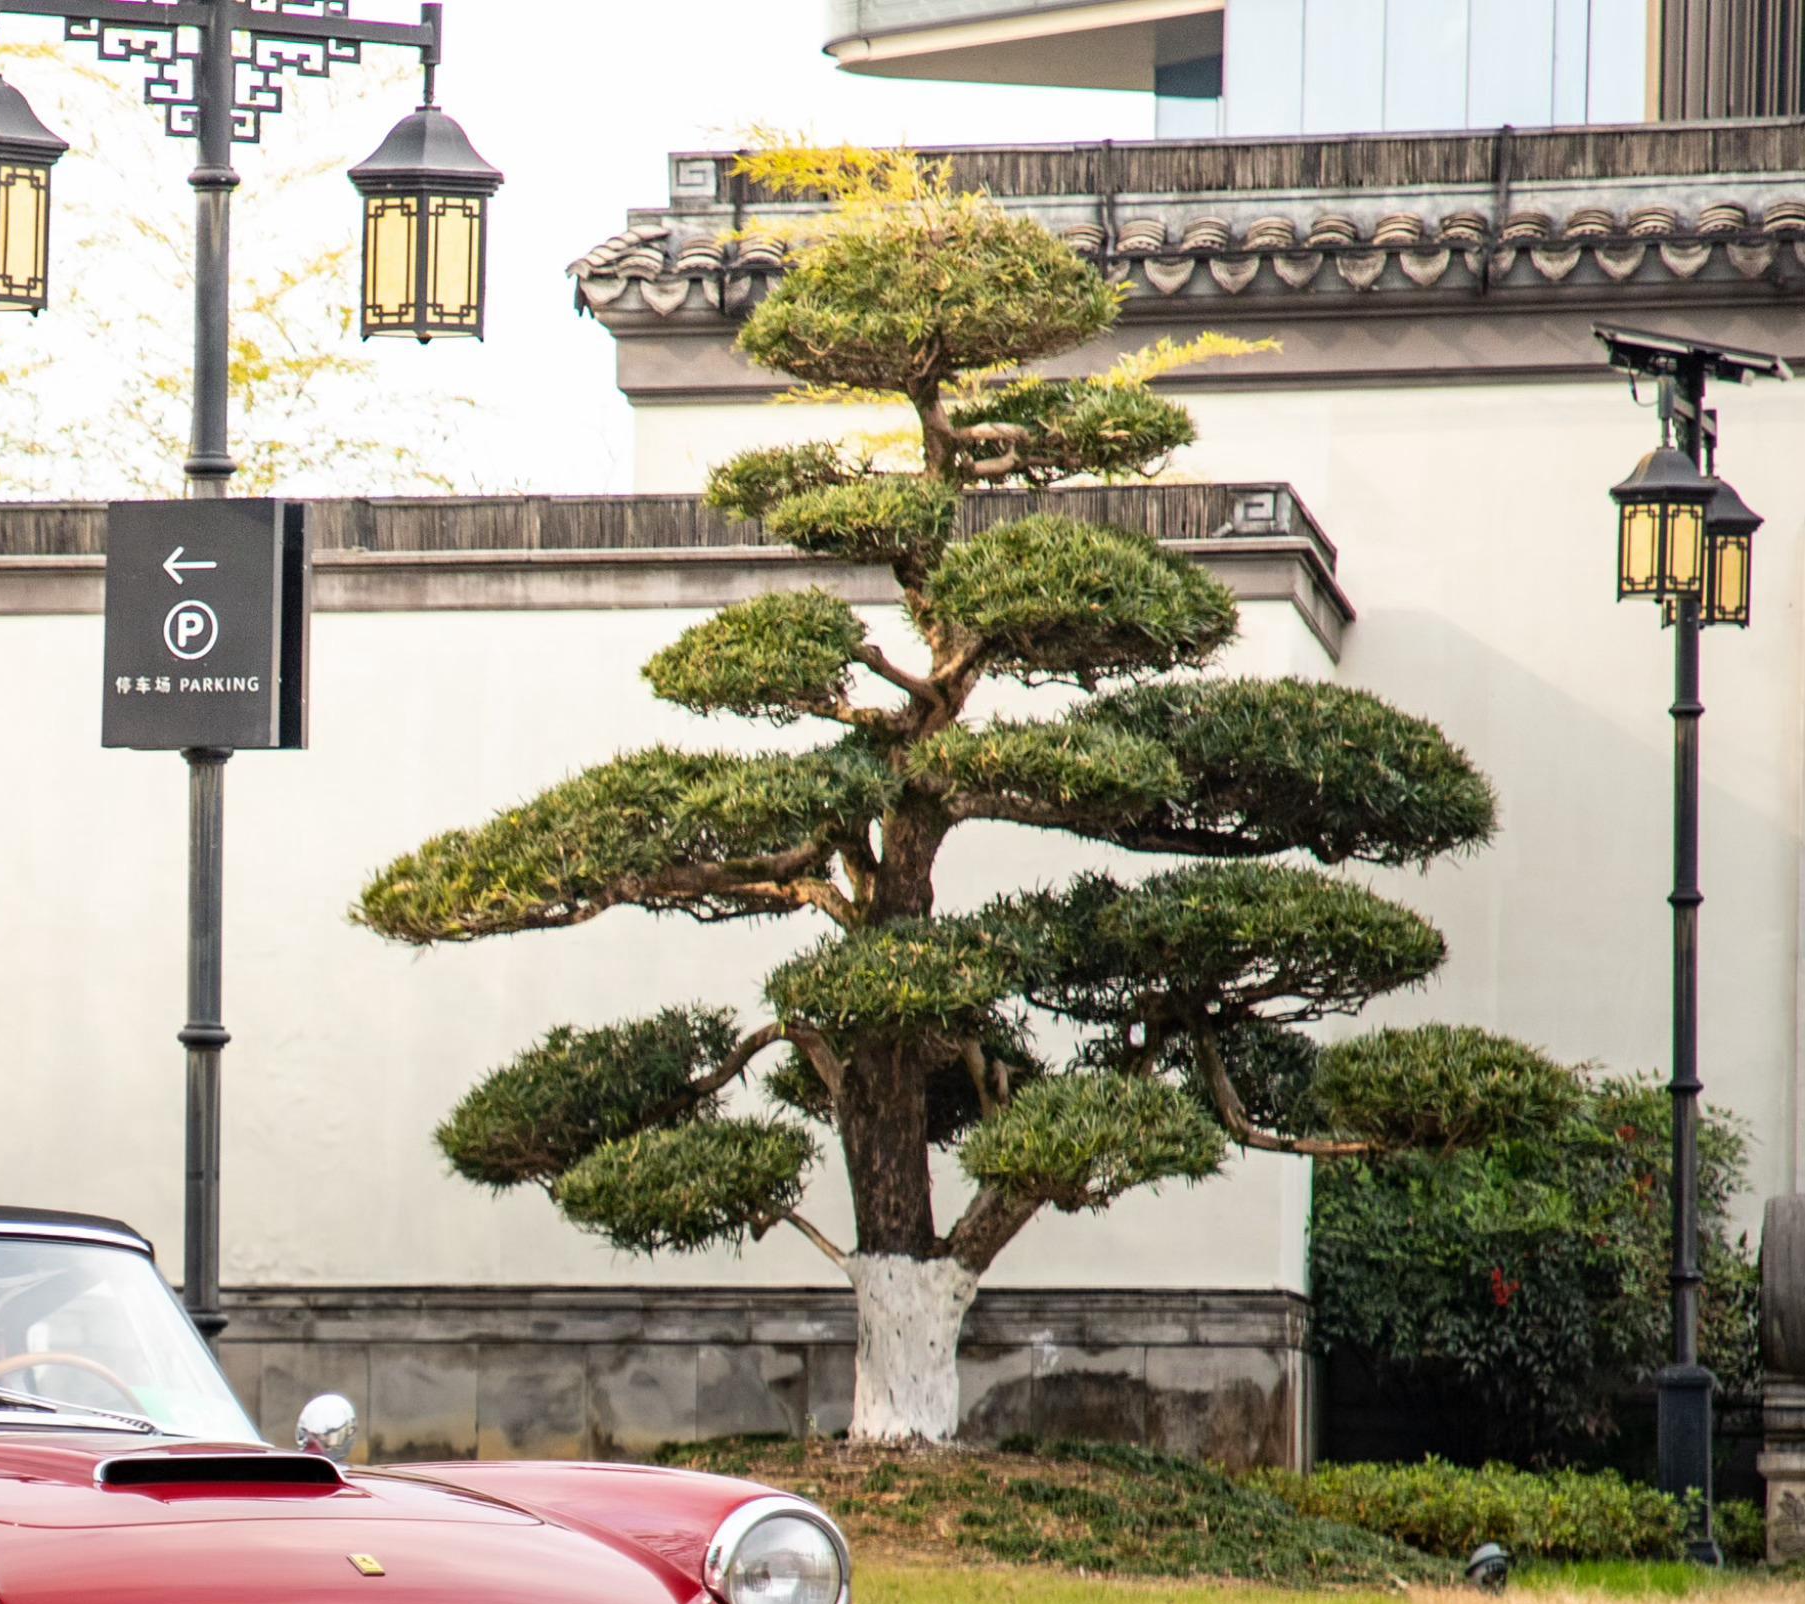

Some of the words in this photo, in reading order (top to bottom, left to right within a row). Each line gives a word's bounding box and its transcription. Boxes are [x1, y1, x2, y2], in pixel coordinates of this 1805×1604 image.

[177, 612, 204, 648] P
[115, 676, 171, 695] 停车场
[179, 676, 260, 693] PARKING
